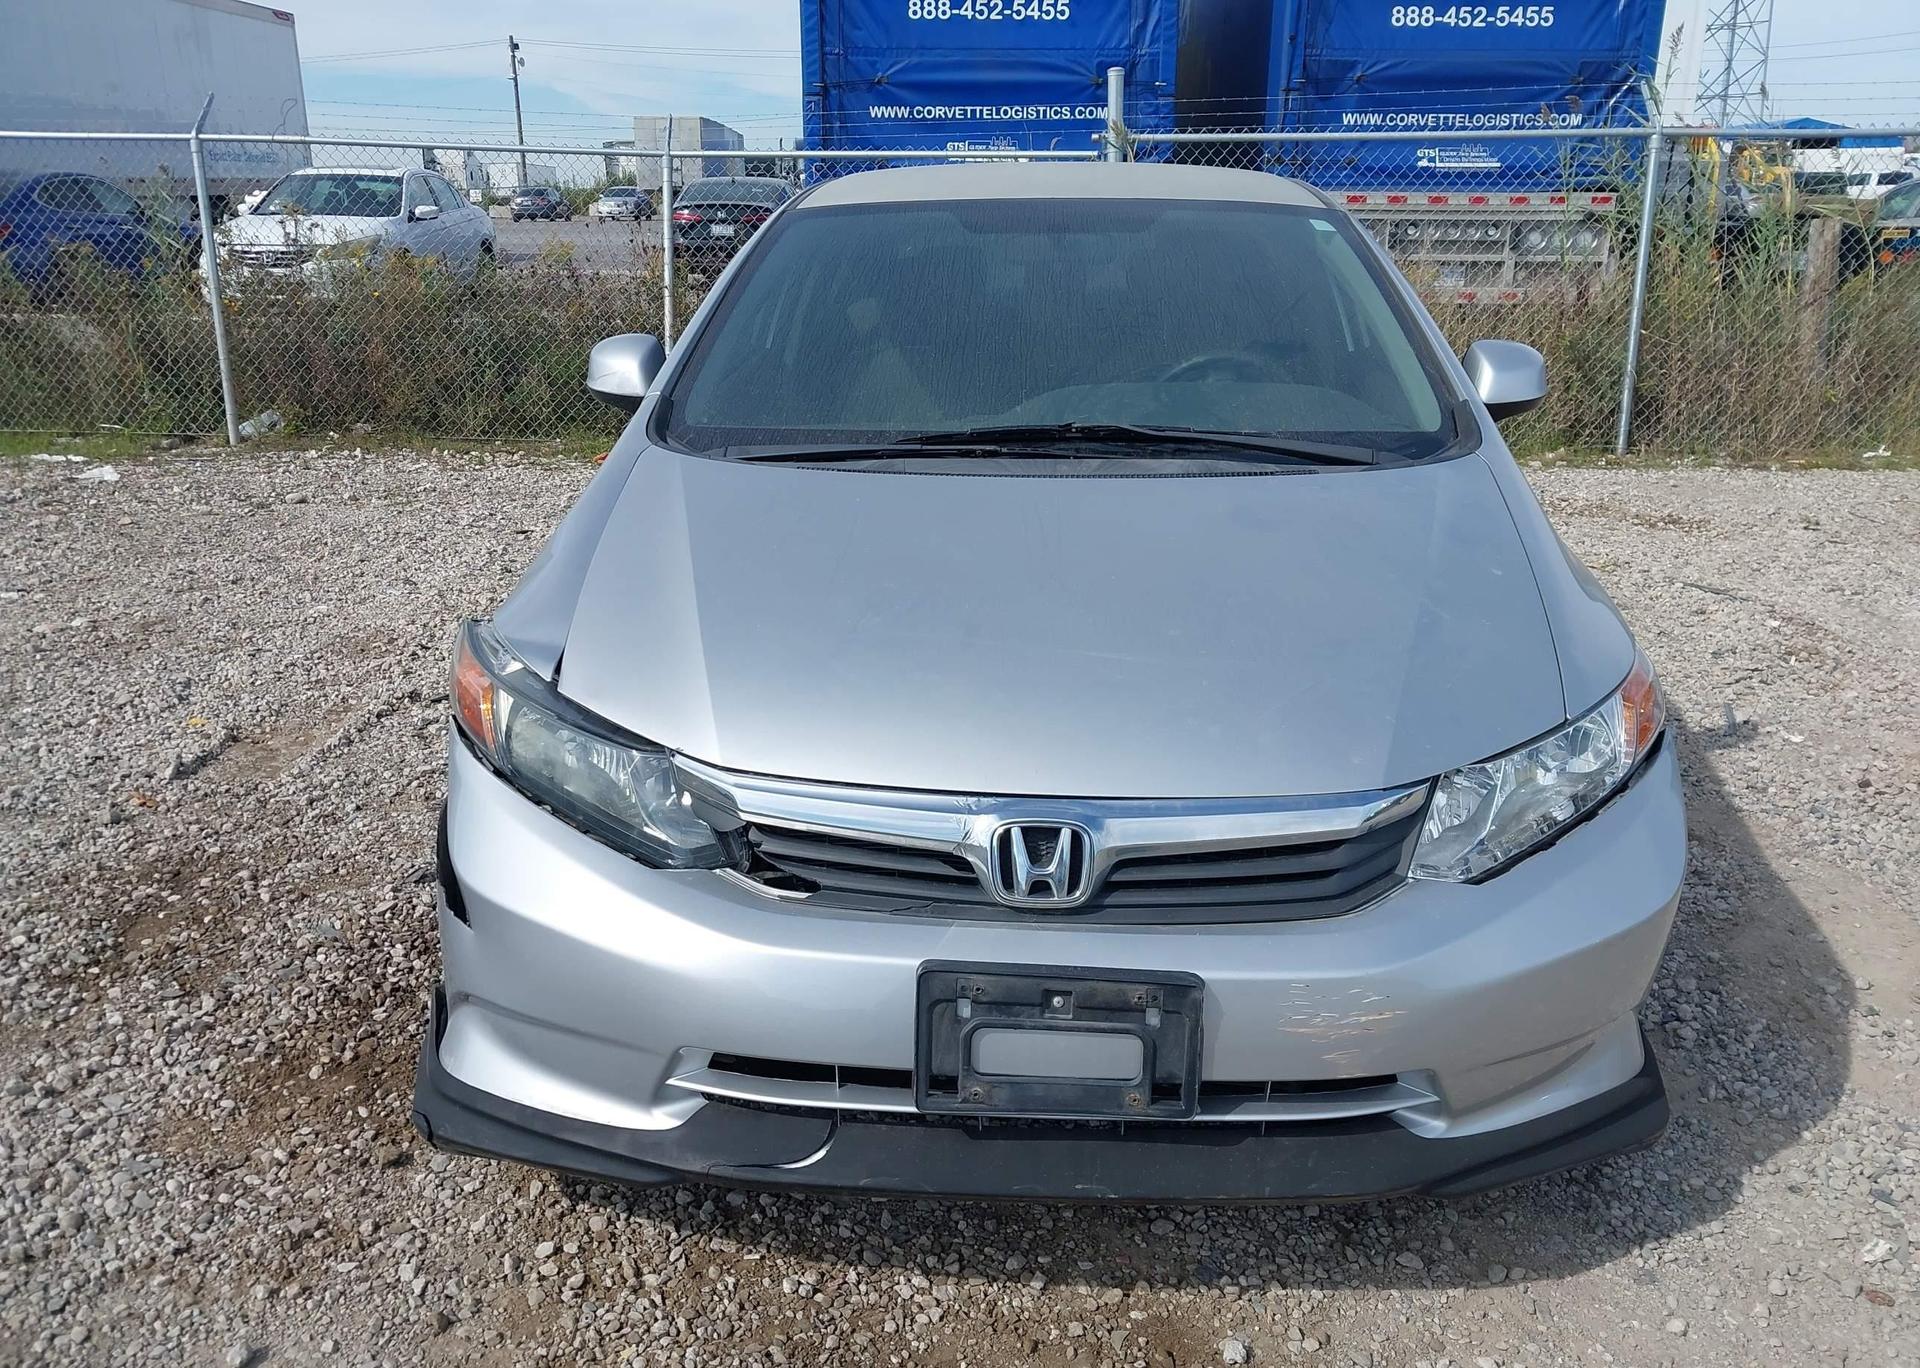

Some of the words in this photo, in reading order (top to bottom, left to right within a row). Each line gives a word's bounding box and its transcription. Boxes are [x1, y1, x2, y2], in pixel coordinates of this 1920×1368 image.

[908, 0, 1070, 20] 888-452-5455
[1391, 6, 1555, 27] 888-452-5455
[869, 106, 1108, 119] WWW.CORVETTELOGISTICS.COM
[1342, 112, 1583, 126] WWW.CORVETTELOGISTICS.COM
[946, 142, 965, 151] GTS
[1417, 148, 1436, 157] GTS
